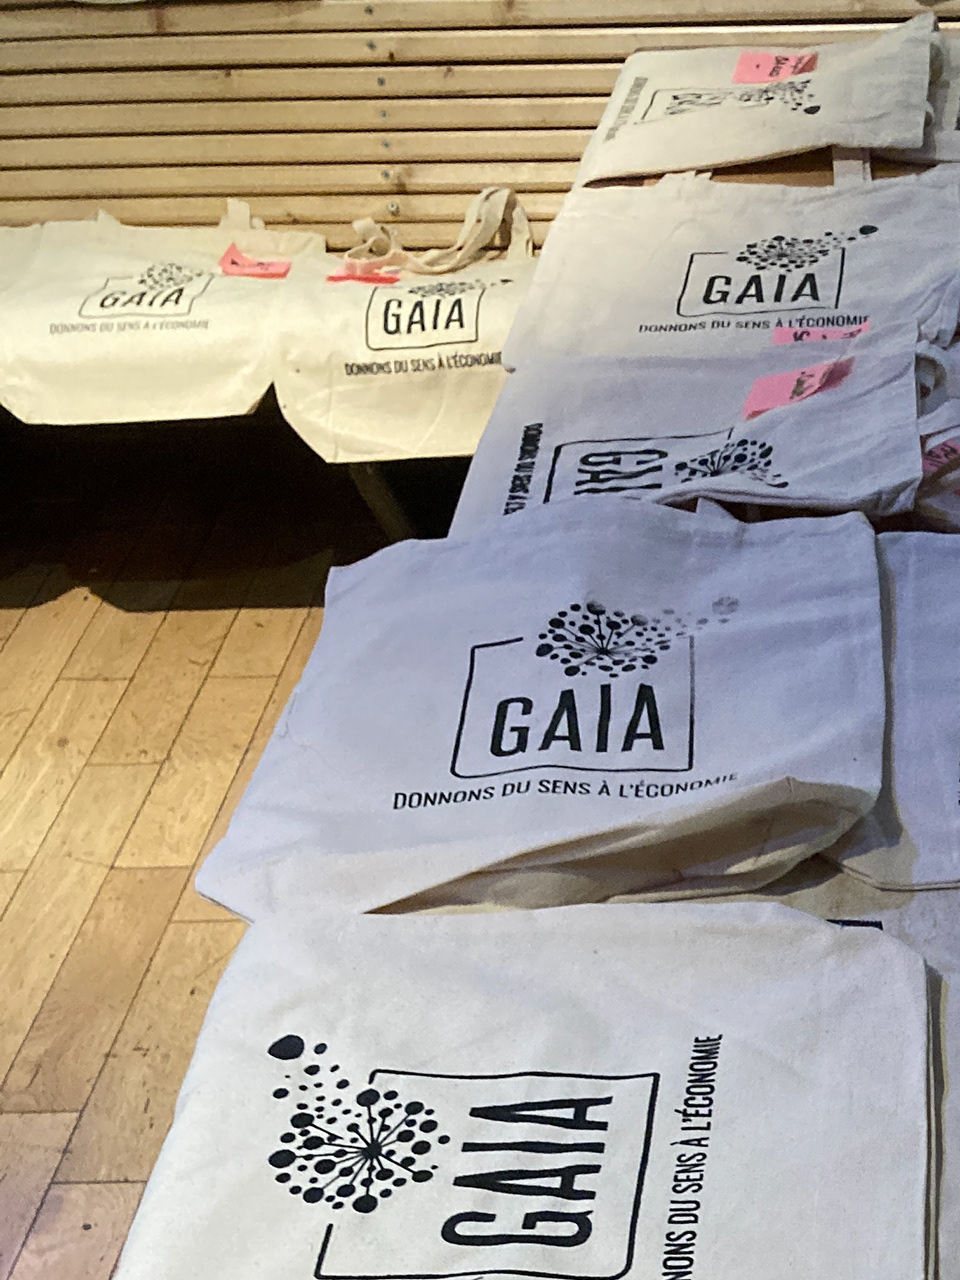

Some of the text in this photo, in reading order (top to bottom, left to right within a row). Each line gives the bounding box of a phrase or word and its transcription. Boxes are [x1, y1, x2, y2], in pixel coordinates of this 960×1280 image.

[100, 286, 184, 308] GAIA
[703, 273, 820, 305] GAIA
[383, 298, 464, 335] GAIA
[638, 321, 706, 333] DONNONS
[711, 320, 731, 329] DU
[735, 320, 770, 329] SENS
[573, 448, 669, 496] GAI
[490, 682, 665, 758] GAIA
[393, 772, 738, 810] DONNONS DU SENS À L'ÉCONOMIE
[674, 1034, 723, 1132] L'ÉCONOMIE
[670, 1137, 710, 1147] À
[441, 1096, 613, 1247] GAIA
[672, 1152, 707, 1194] SENS
[667, 1200, 700, 1225] DU
